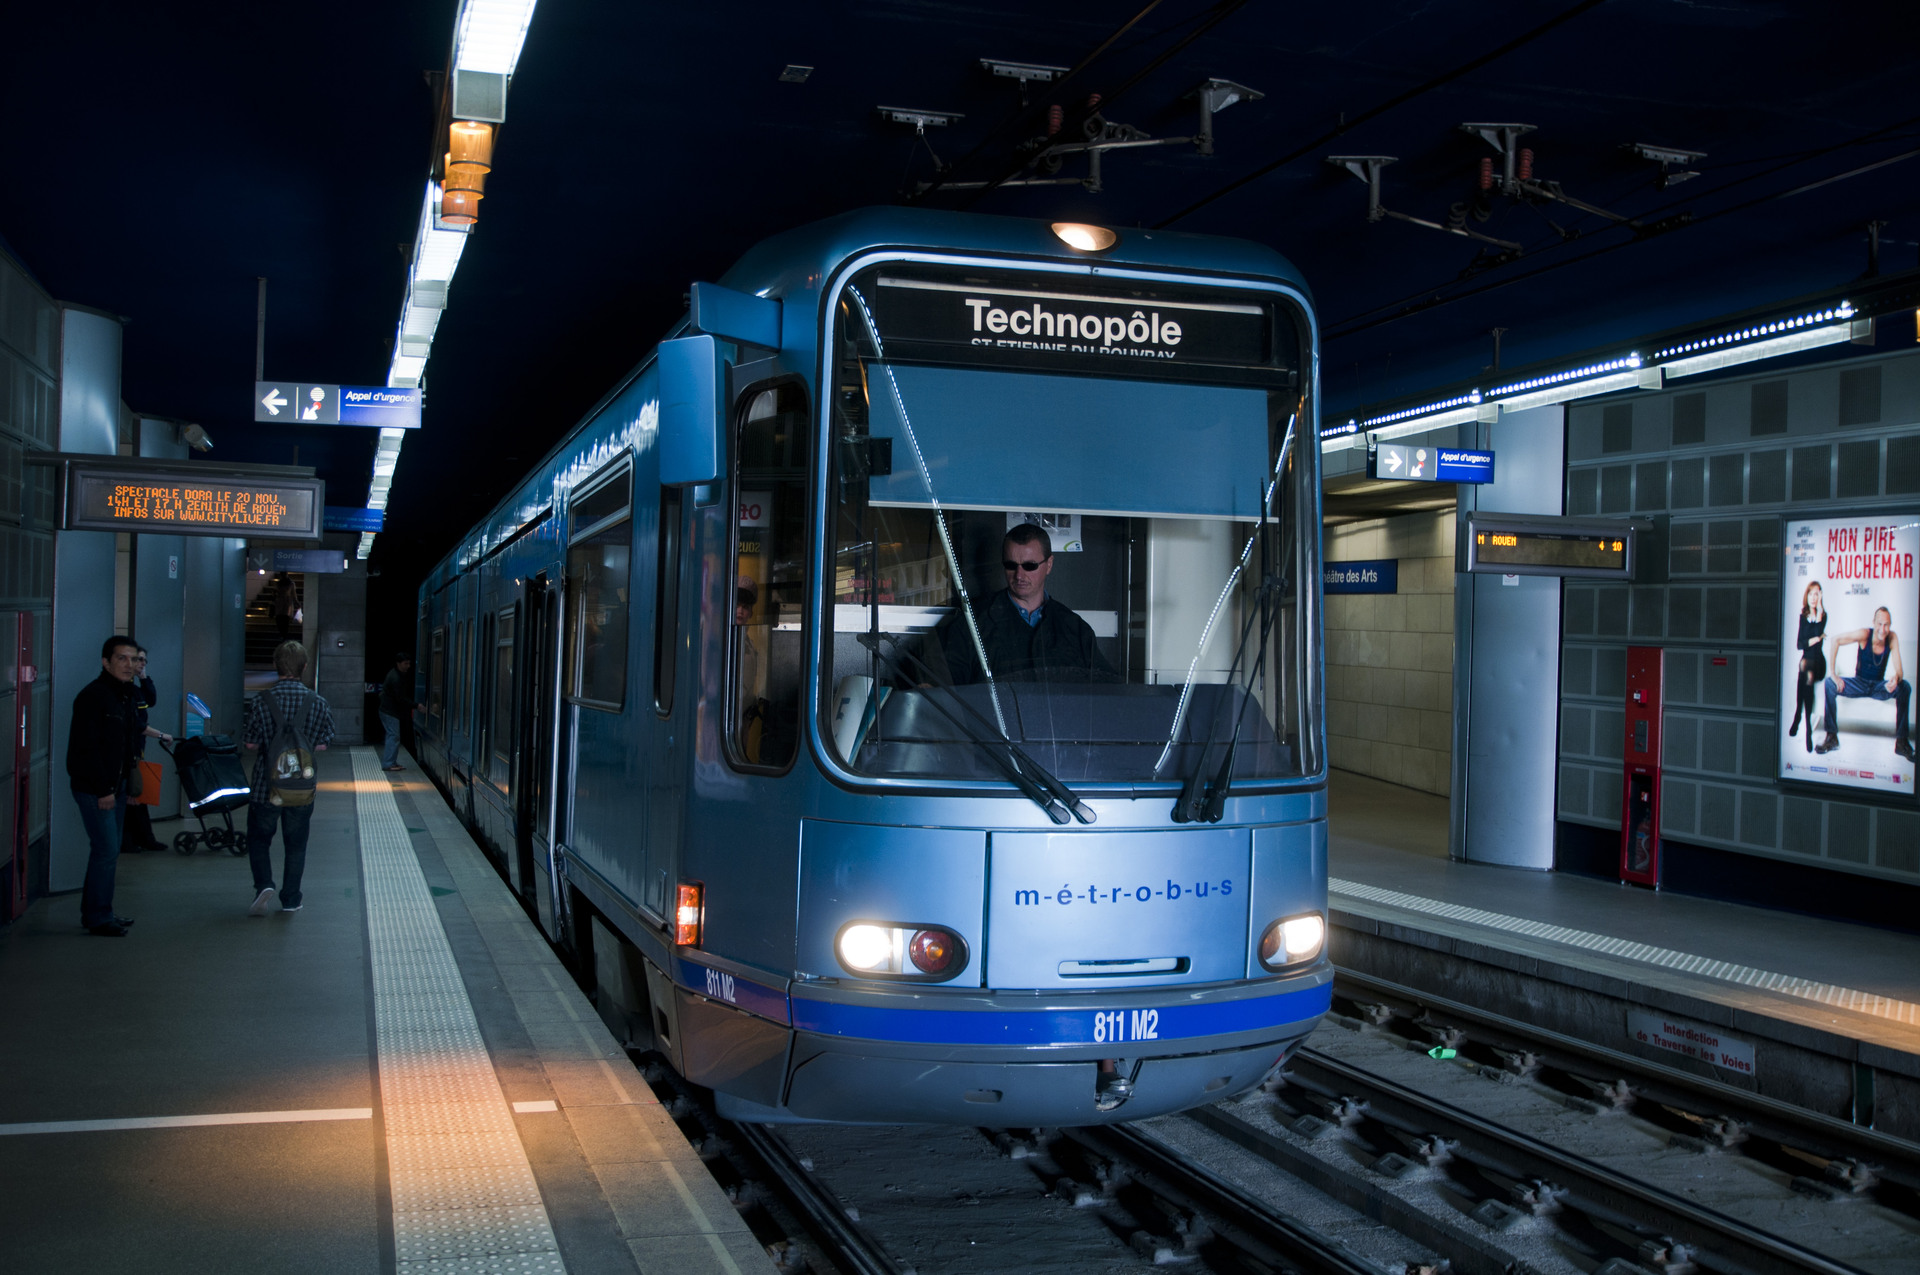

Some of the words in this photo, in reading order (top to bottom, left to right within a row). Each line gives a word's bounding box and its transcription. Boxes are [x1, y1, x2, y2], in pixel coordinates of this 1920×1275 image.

[965, 298, 1182, 347] Technopôle
[345, 391, 372, 402] Appel
[373, 392, 416, 403] d'urgence
[1441, 452, 1460, 462] Appel
[1460, 453, 1490, 463] d'urgence
[107, 494, 129, 507] 14H
[134, 497, 150, 508] ET
[155, 498, 170, 509] 17
[174, 499, 182, 510] H
[187, 500, 228, 513] ZENITH
[233, 502, 247, 513] DE
[252, 503, 286, 516] ROUEN
[115, 485, 180, 499] SPECTACLE
[184, 489, 213, 501] DORA
[217, 491, 232, 502] LE
[236, 492, 251, 503] 20
[255, 493, 280, 505] NOV.
[114, 506, 149, 519] INFOS
[153, 508, 175, 520] SUR
[180, 509, 279, 526] WWW.CITYLIVE.FR
[1492, 535, 1517, 546] ROUEN
[1598, 540, 1605, 551] 4
[1612, 541, 1623, 551] 10
[1828, 527, 1858, 553] MON
[1864, 526, 1897, 552] PIRE
[277, 551, 303, 560] Sortie
[1827, 553, 1913, 579] CAUCHEMAR
[1323, 570, 1345, 583] héâtre
[1346, 569, 1360, 583] des
[1360, 568, 1378, 583] Arts
[706, 967, 721, 998] 811
[721, 972, 736, 1003] M2
[1093, 1011, 1125, 1043] 811
[1131, 1009, 1159, 1041] M2
[1663, 1022, 1719, 1048] Interdiction
[1636, 1030, 1648, 1042] de
[1652, 1033, 1696, 1056] Traverser
[1700, 1050, 1716, 1062] les
[1721, 1053, 1751, 1072] Voies
